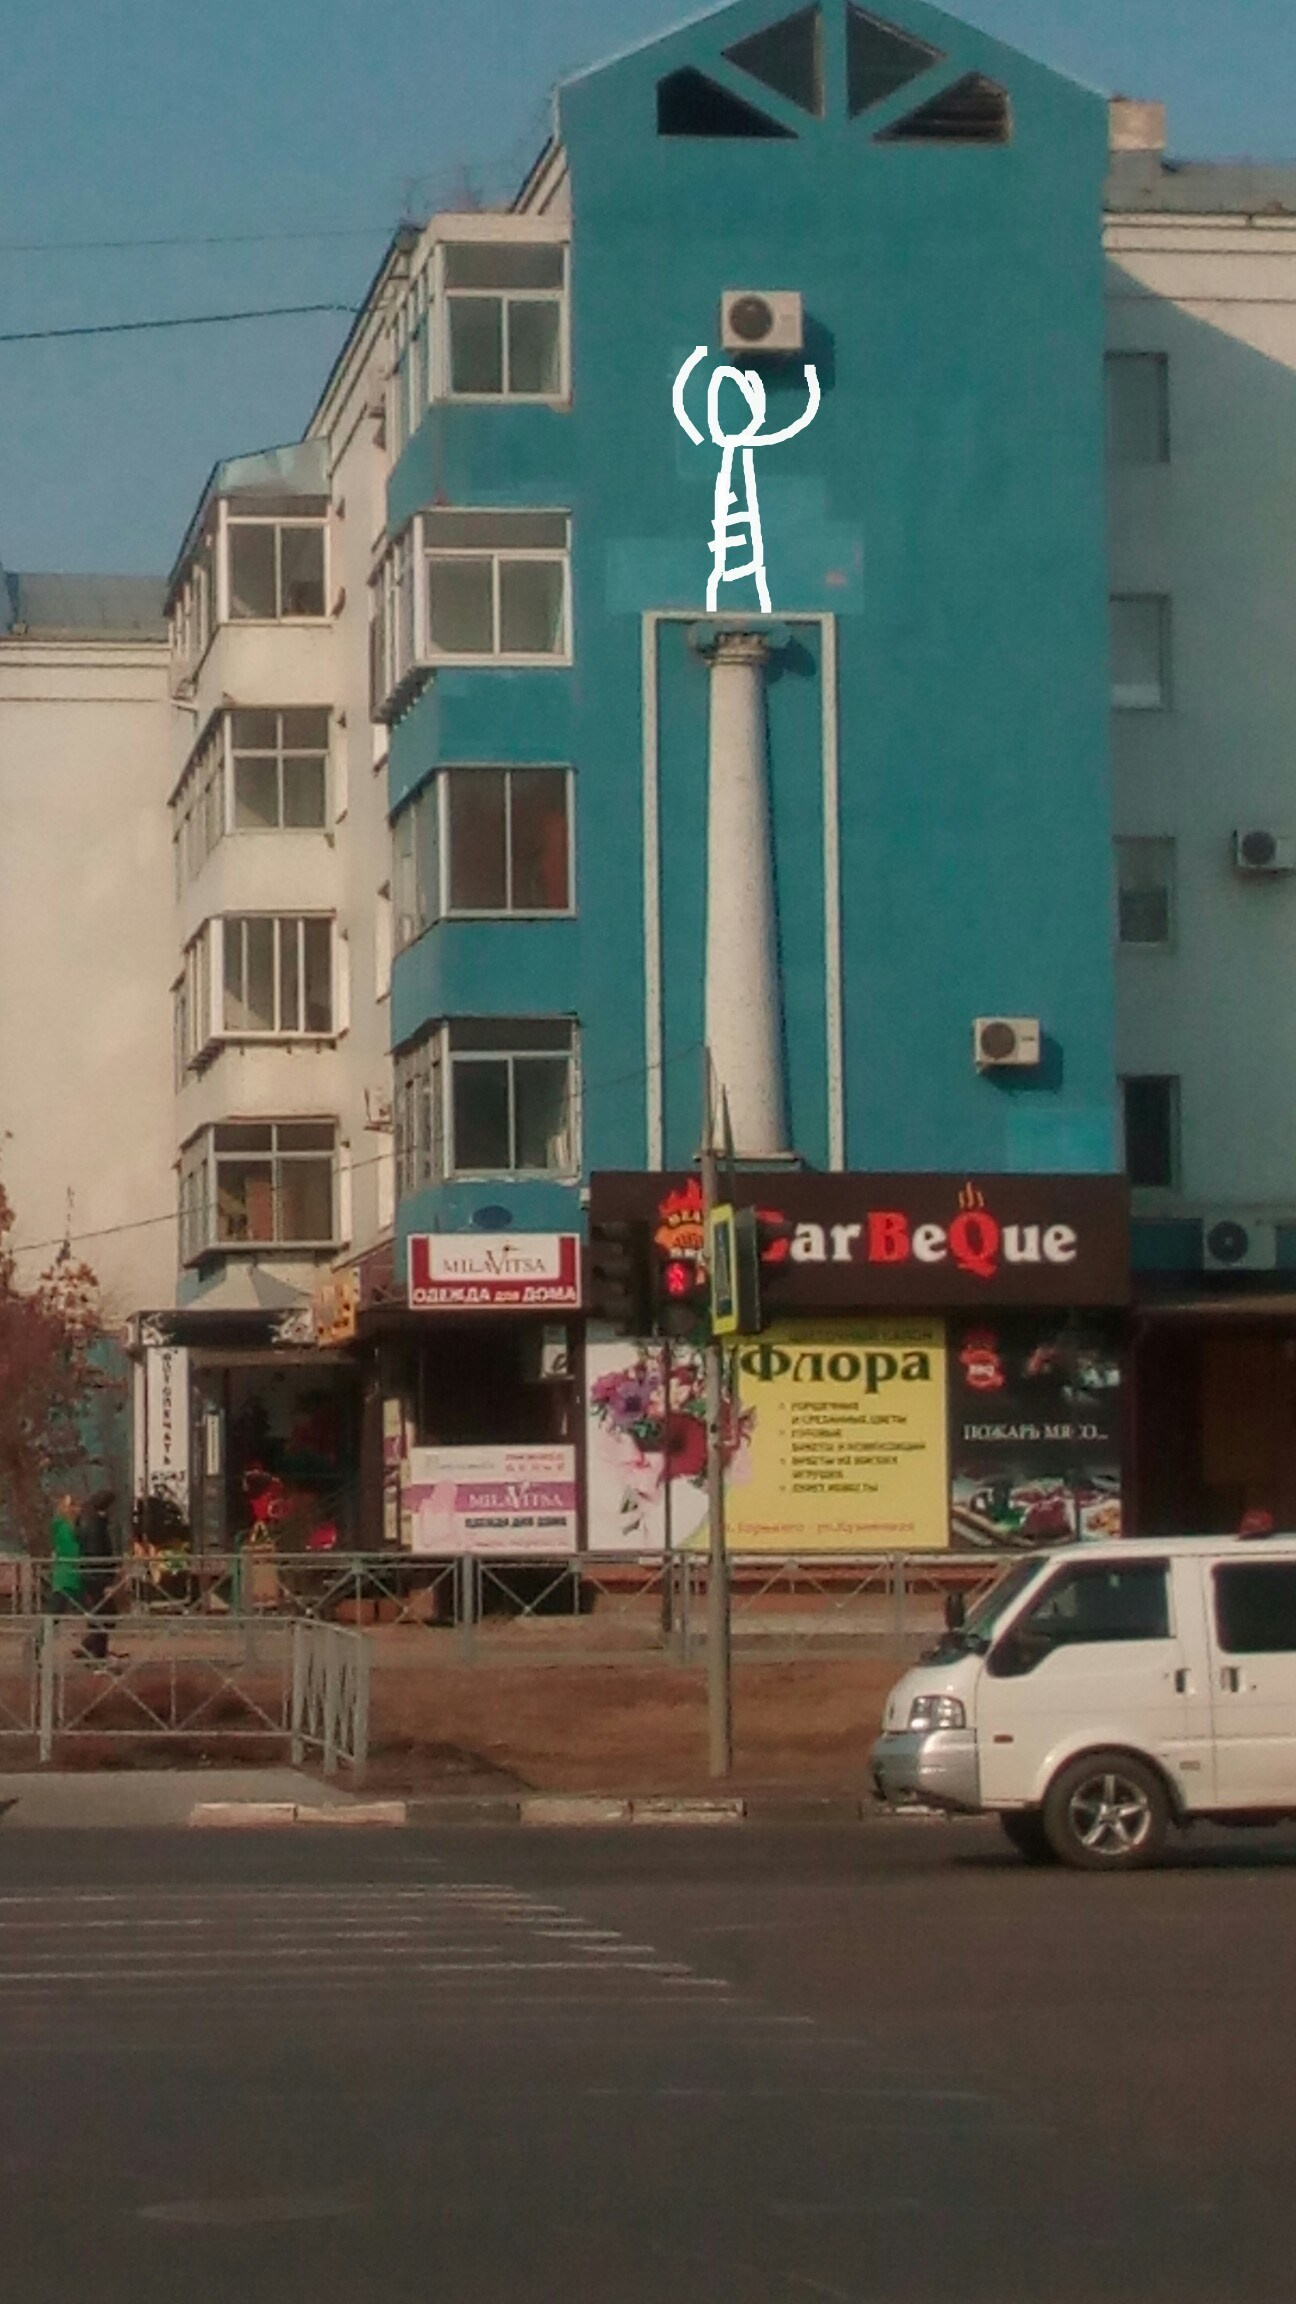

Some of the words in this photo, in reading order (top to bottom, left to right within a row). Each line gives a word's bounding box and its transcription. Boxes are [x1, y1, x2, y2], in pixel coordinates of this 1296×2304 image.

[412, 1286, 490, 1303] ОДЕЖДА
[522, 1285, 577, 1302] ДОМА
[740, 1343, 930, 1394] Флора
